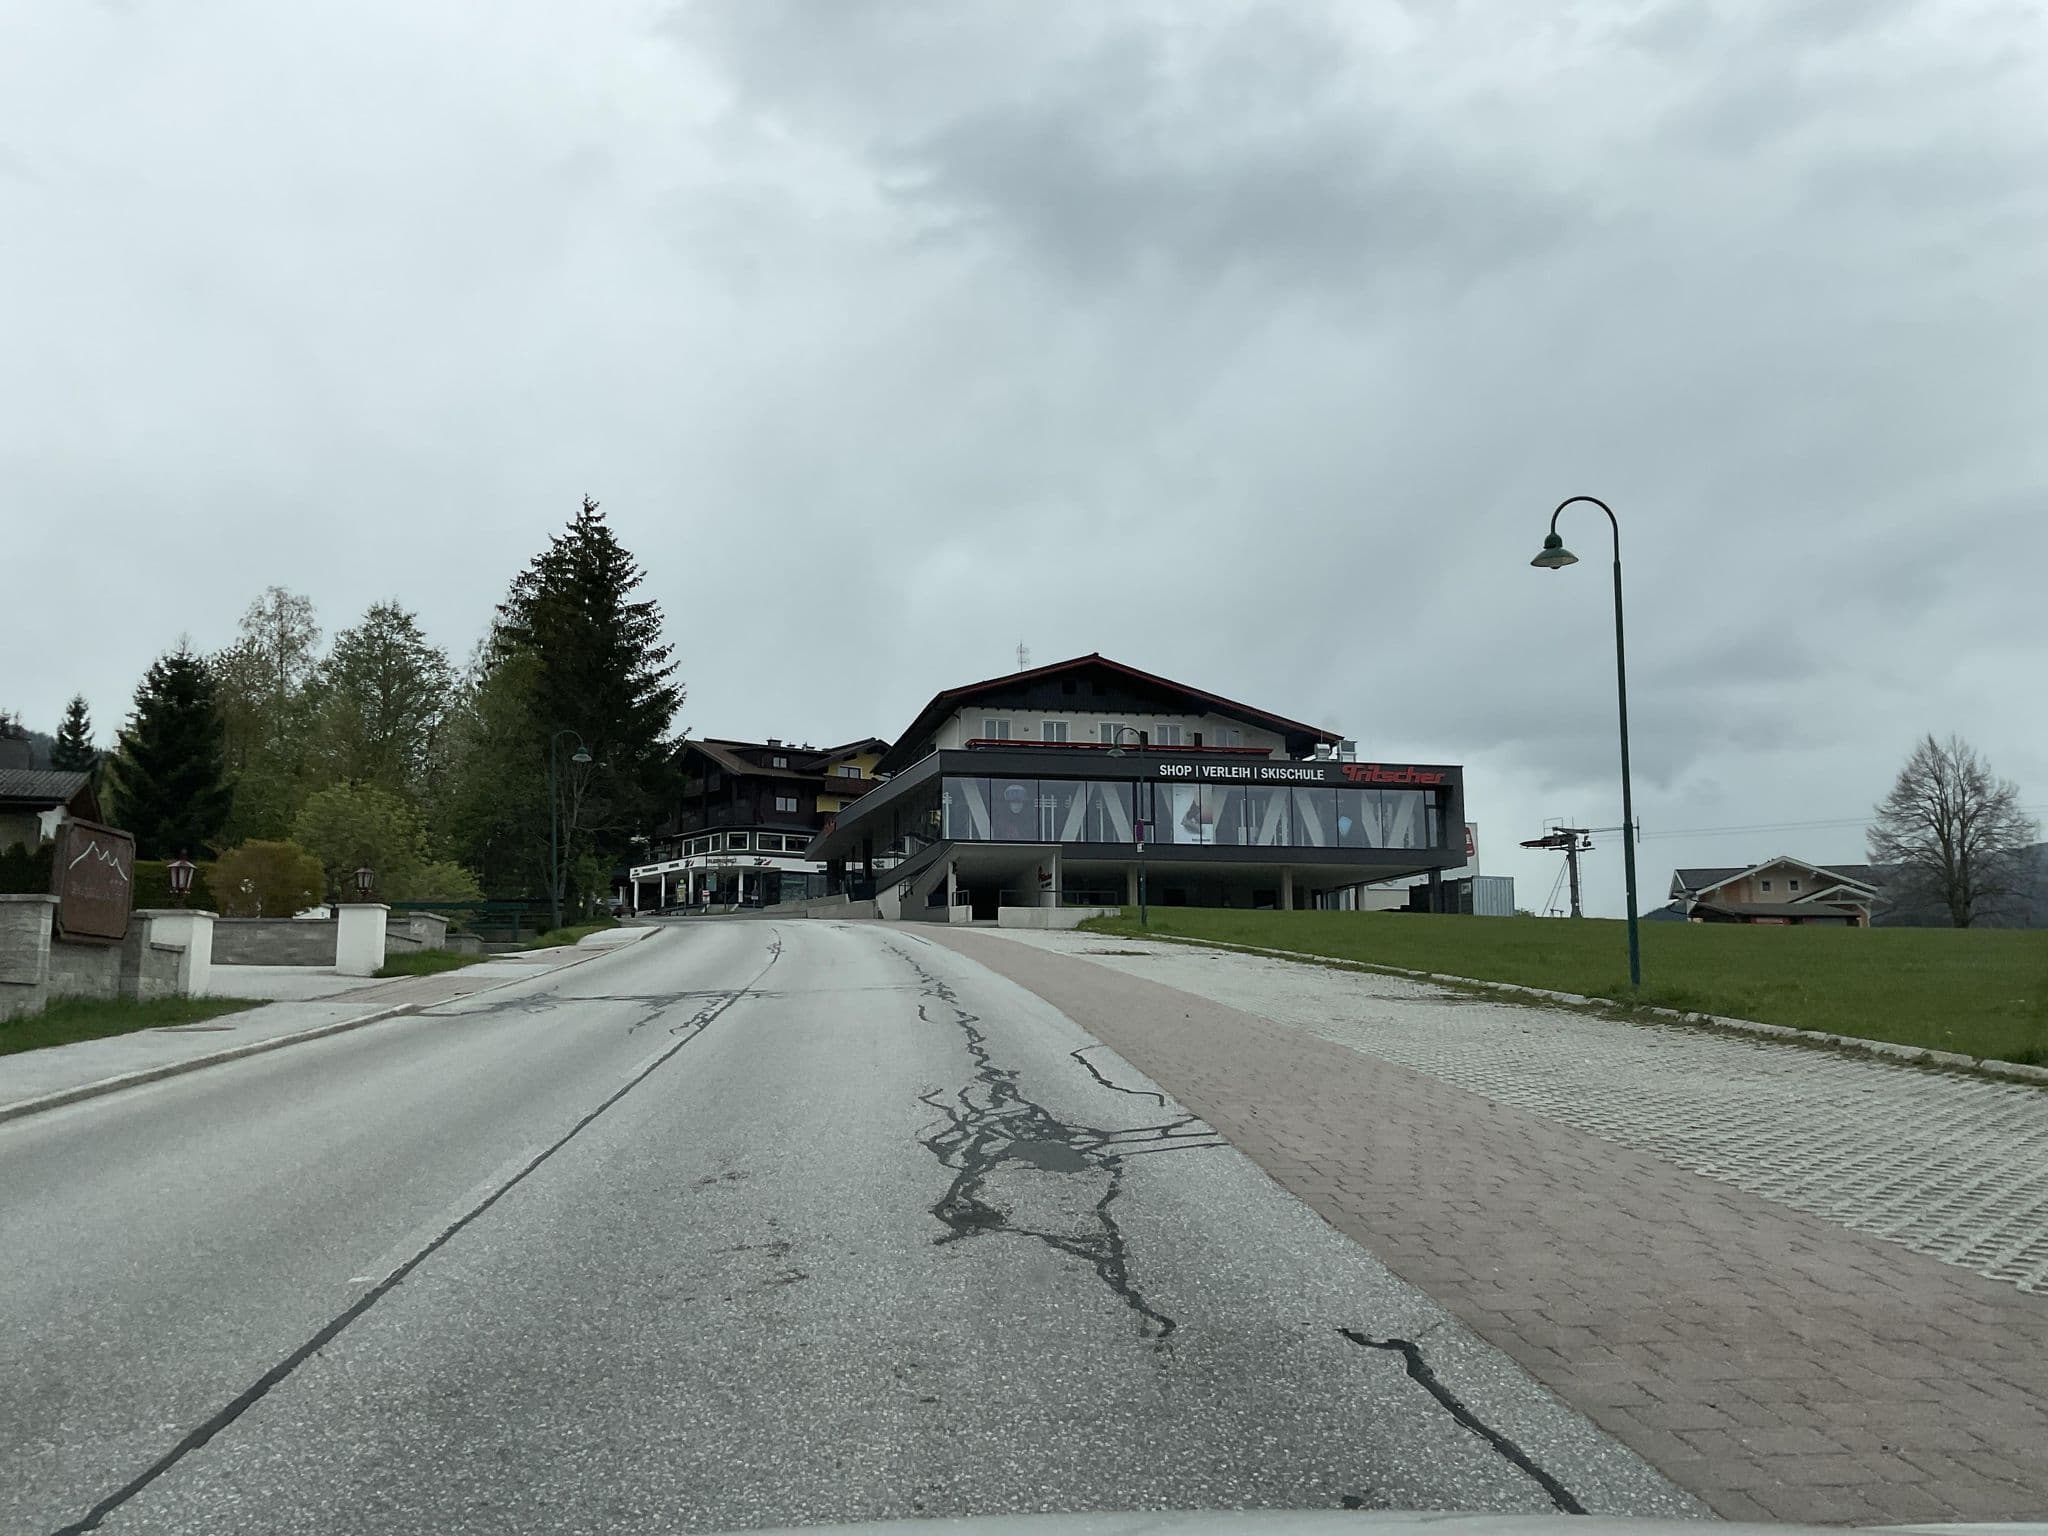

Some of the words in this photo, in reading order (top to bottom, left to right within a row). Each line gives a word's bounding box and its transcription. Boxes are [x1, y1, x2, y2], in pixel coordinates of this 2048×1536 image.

[1159, 765, 1192, 777] SHOP
[1202, 765, 1251, 778] VERLEIH
[1260, 768, 1325, 781] SKISCHULE
[1342, 764, 1445, 784] Tritscher
